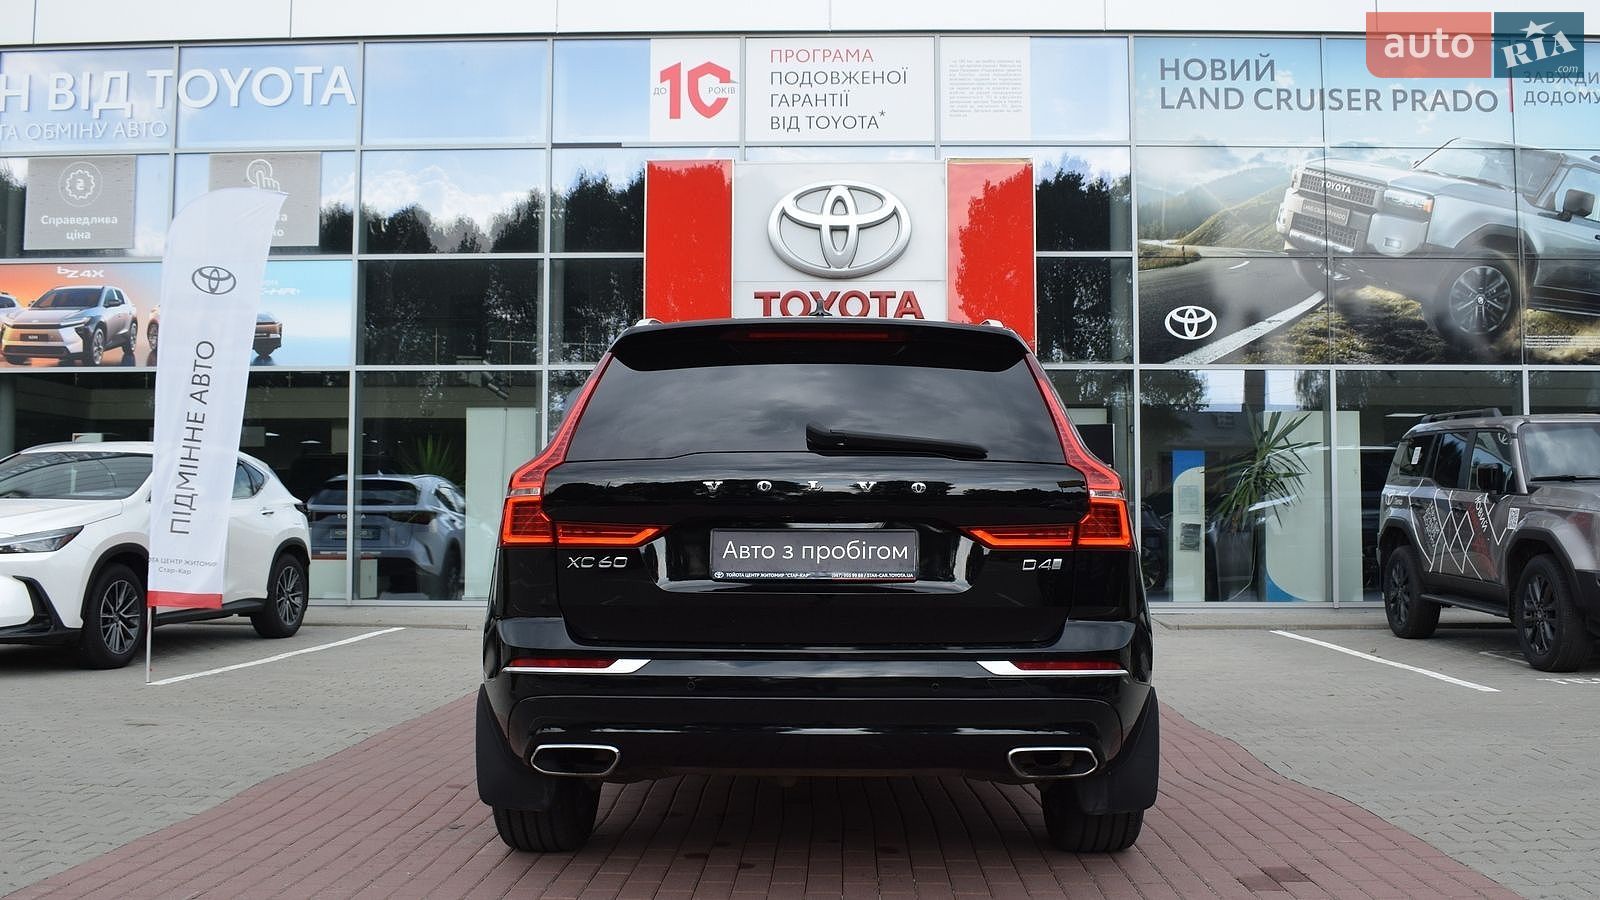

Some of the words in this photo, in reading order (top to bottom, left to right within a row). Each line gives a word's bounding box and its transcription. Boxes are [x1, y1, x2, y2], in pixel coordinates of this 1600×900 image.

[770, 48, 875, 63] ПРОГРАМА
[1160, 52, 1276, 82] НОВИЙ
[770, 66, 909, 88] ПОДОВЖЕНОЇ
[1523, 71, 1599, 87] ЗАВЖДИ
[50, 71, 134, 119] ВІД
[147, 66, 357, 109] TOYOTA
[653, 87, 667, 96] ДО
[708, 87, 736, 95] РОКІВ
[770, 89, 850, 107] ГАРАНТІЇ
[1160, 87, 1245, 110] LAND
[1253, 87, 1383, 112] CRUISER
[1392, 89, 1499, 113] PRADO
[25, 122, 108, 140] ОБМІНУ
[113, 120, 168, 138] АВТО
[770, 115, 800, 133] ВІД
[1321, 180, 1351, 194] TOYOTA
[40, 215, 118, 227] Справедлива
[66, 230, 91, 241] ціна
[754, 290, 925, 319] TOYOTA
[170, 411, 206, 534] ПІДМІННЕ
[190, 340, 215, 405] АВТО
[703, 480, 927, 494] VOLVO
[722, 540, 775, 560] Авто
[782, 544, 794, 560] з
[801, 539, 908, 564] пробігом
